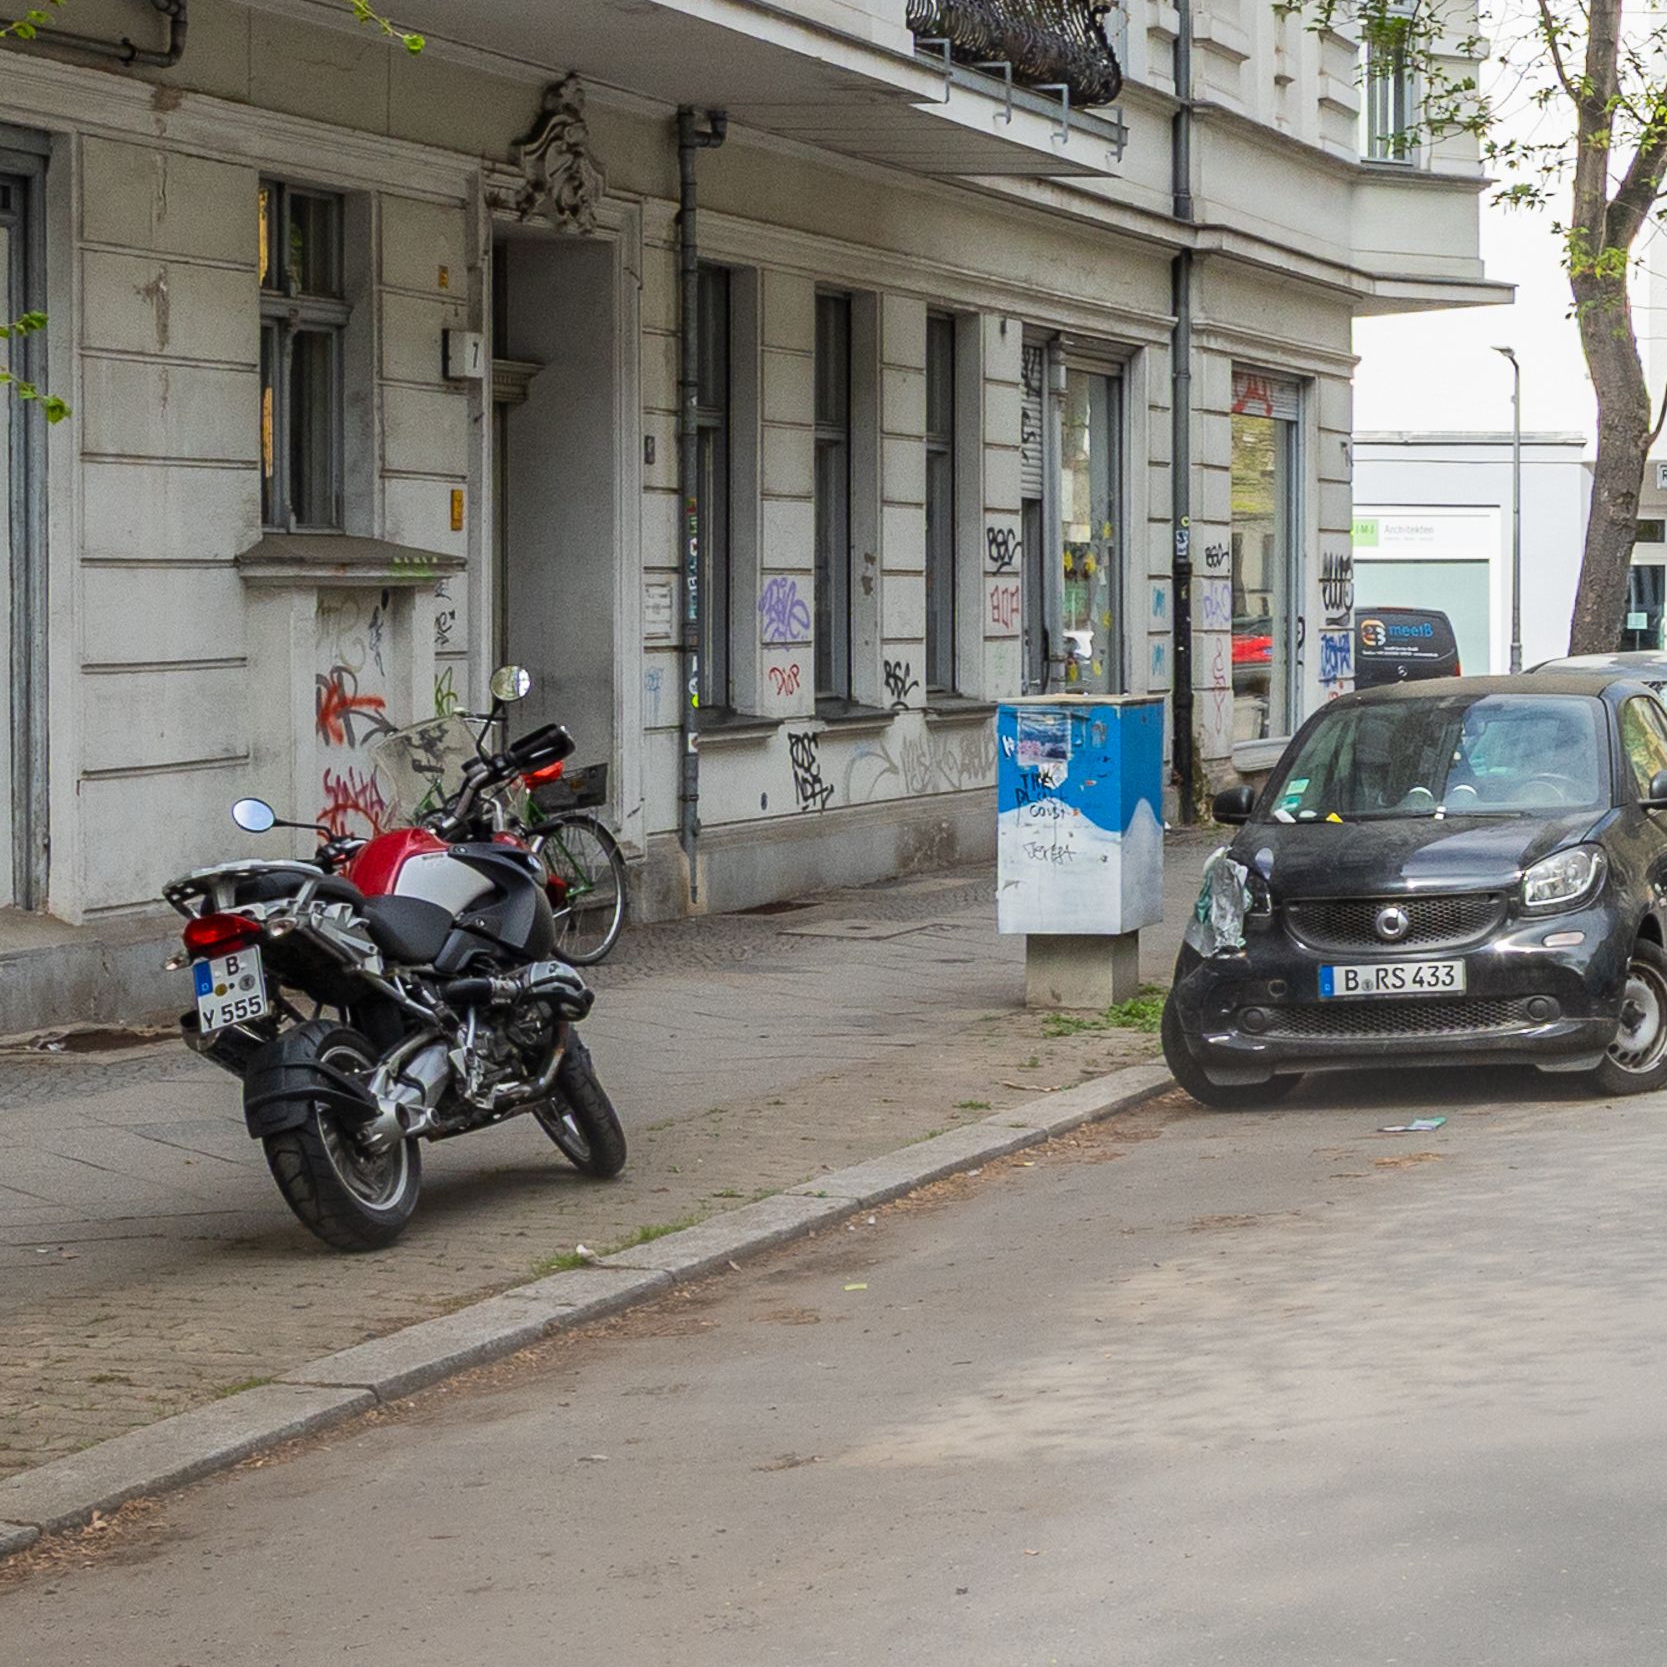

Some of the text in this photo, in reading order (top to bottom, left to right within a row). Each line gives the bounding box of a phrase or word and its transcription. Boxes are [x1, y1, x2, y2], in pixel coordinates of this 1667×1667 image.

[472, 342, 479, 368] 7
[226, 955, 239, 976] B
[1344, 969, 1359, 991] B
[1375, 967, 1406, 990] RS
[1412, 965, 1455, 988] 433
[203, 995, 262, 1029] Y 555
